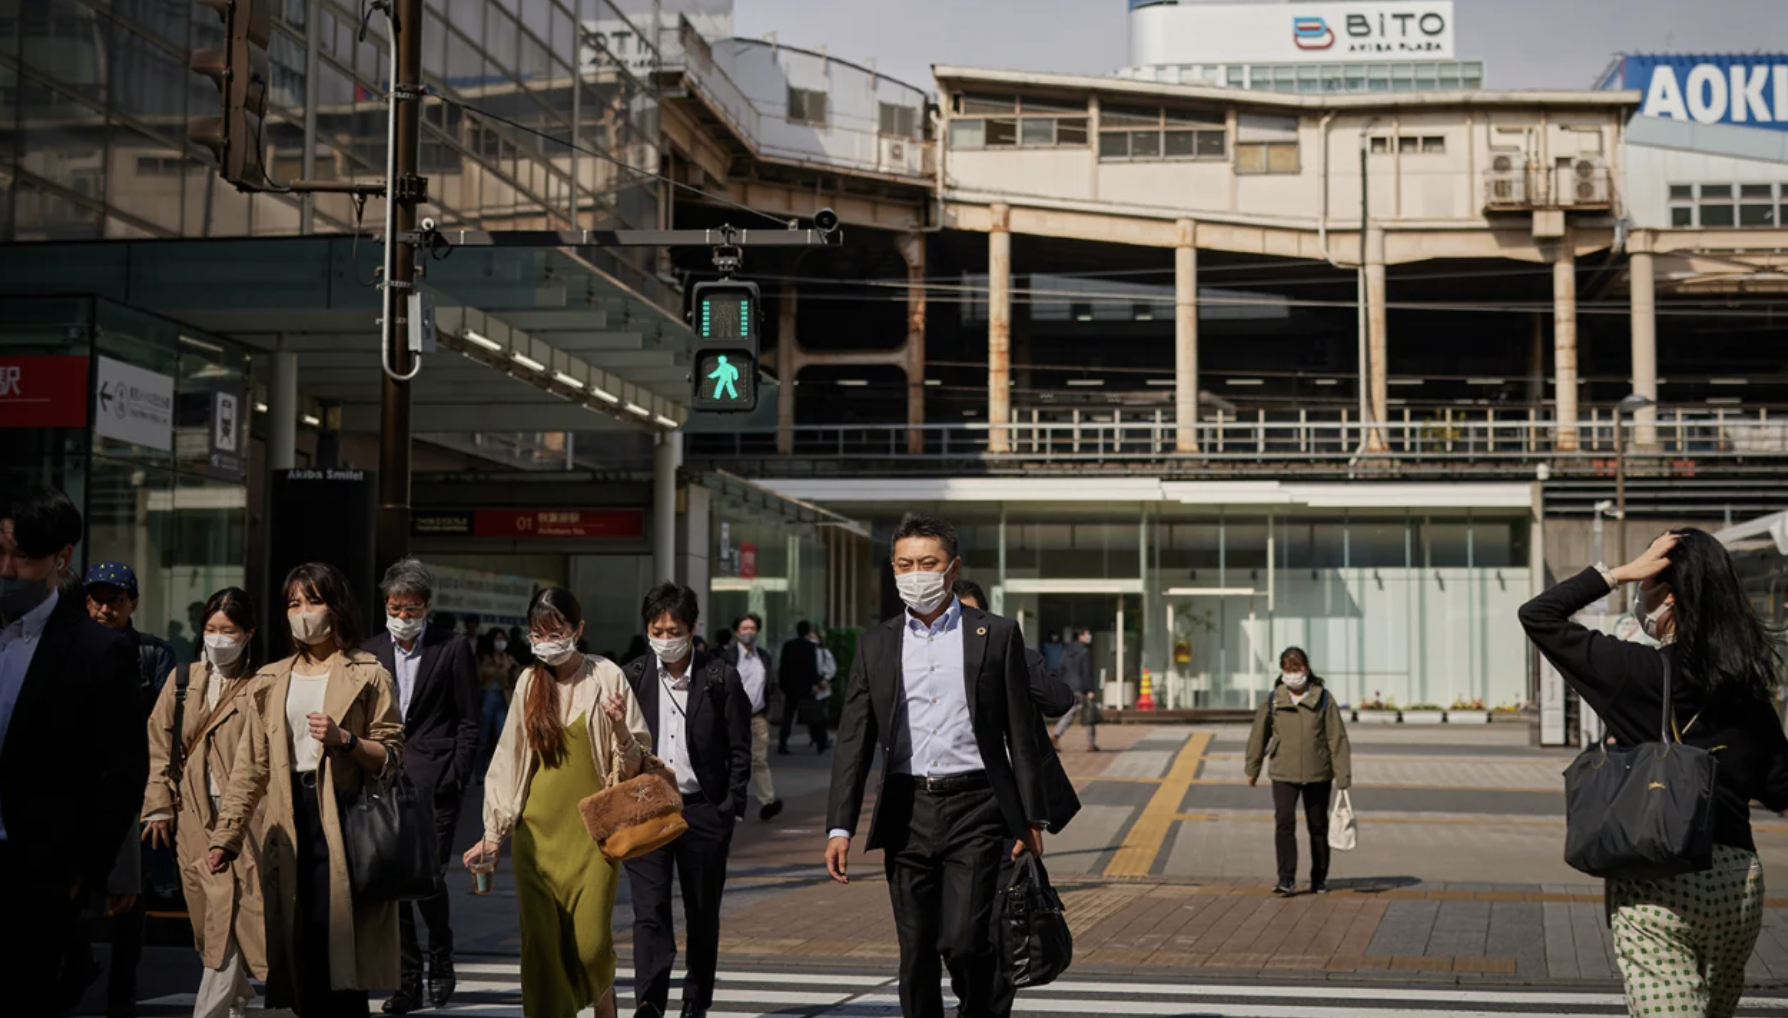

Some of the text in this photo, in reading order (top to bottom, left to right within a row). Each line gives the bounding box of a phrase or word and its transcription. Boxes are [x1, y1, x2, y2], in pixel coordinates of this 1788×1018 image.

[1349, 42, 1443, 52] AKIBA PLAZA
[1643, 63, 1788, 124] AOKI
[287, 469, 323, 480] Akiba
[516, 516, 533, 531] 01
